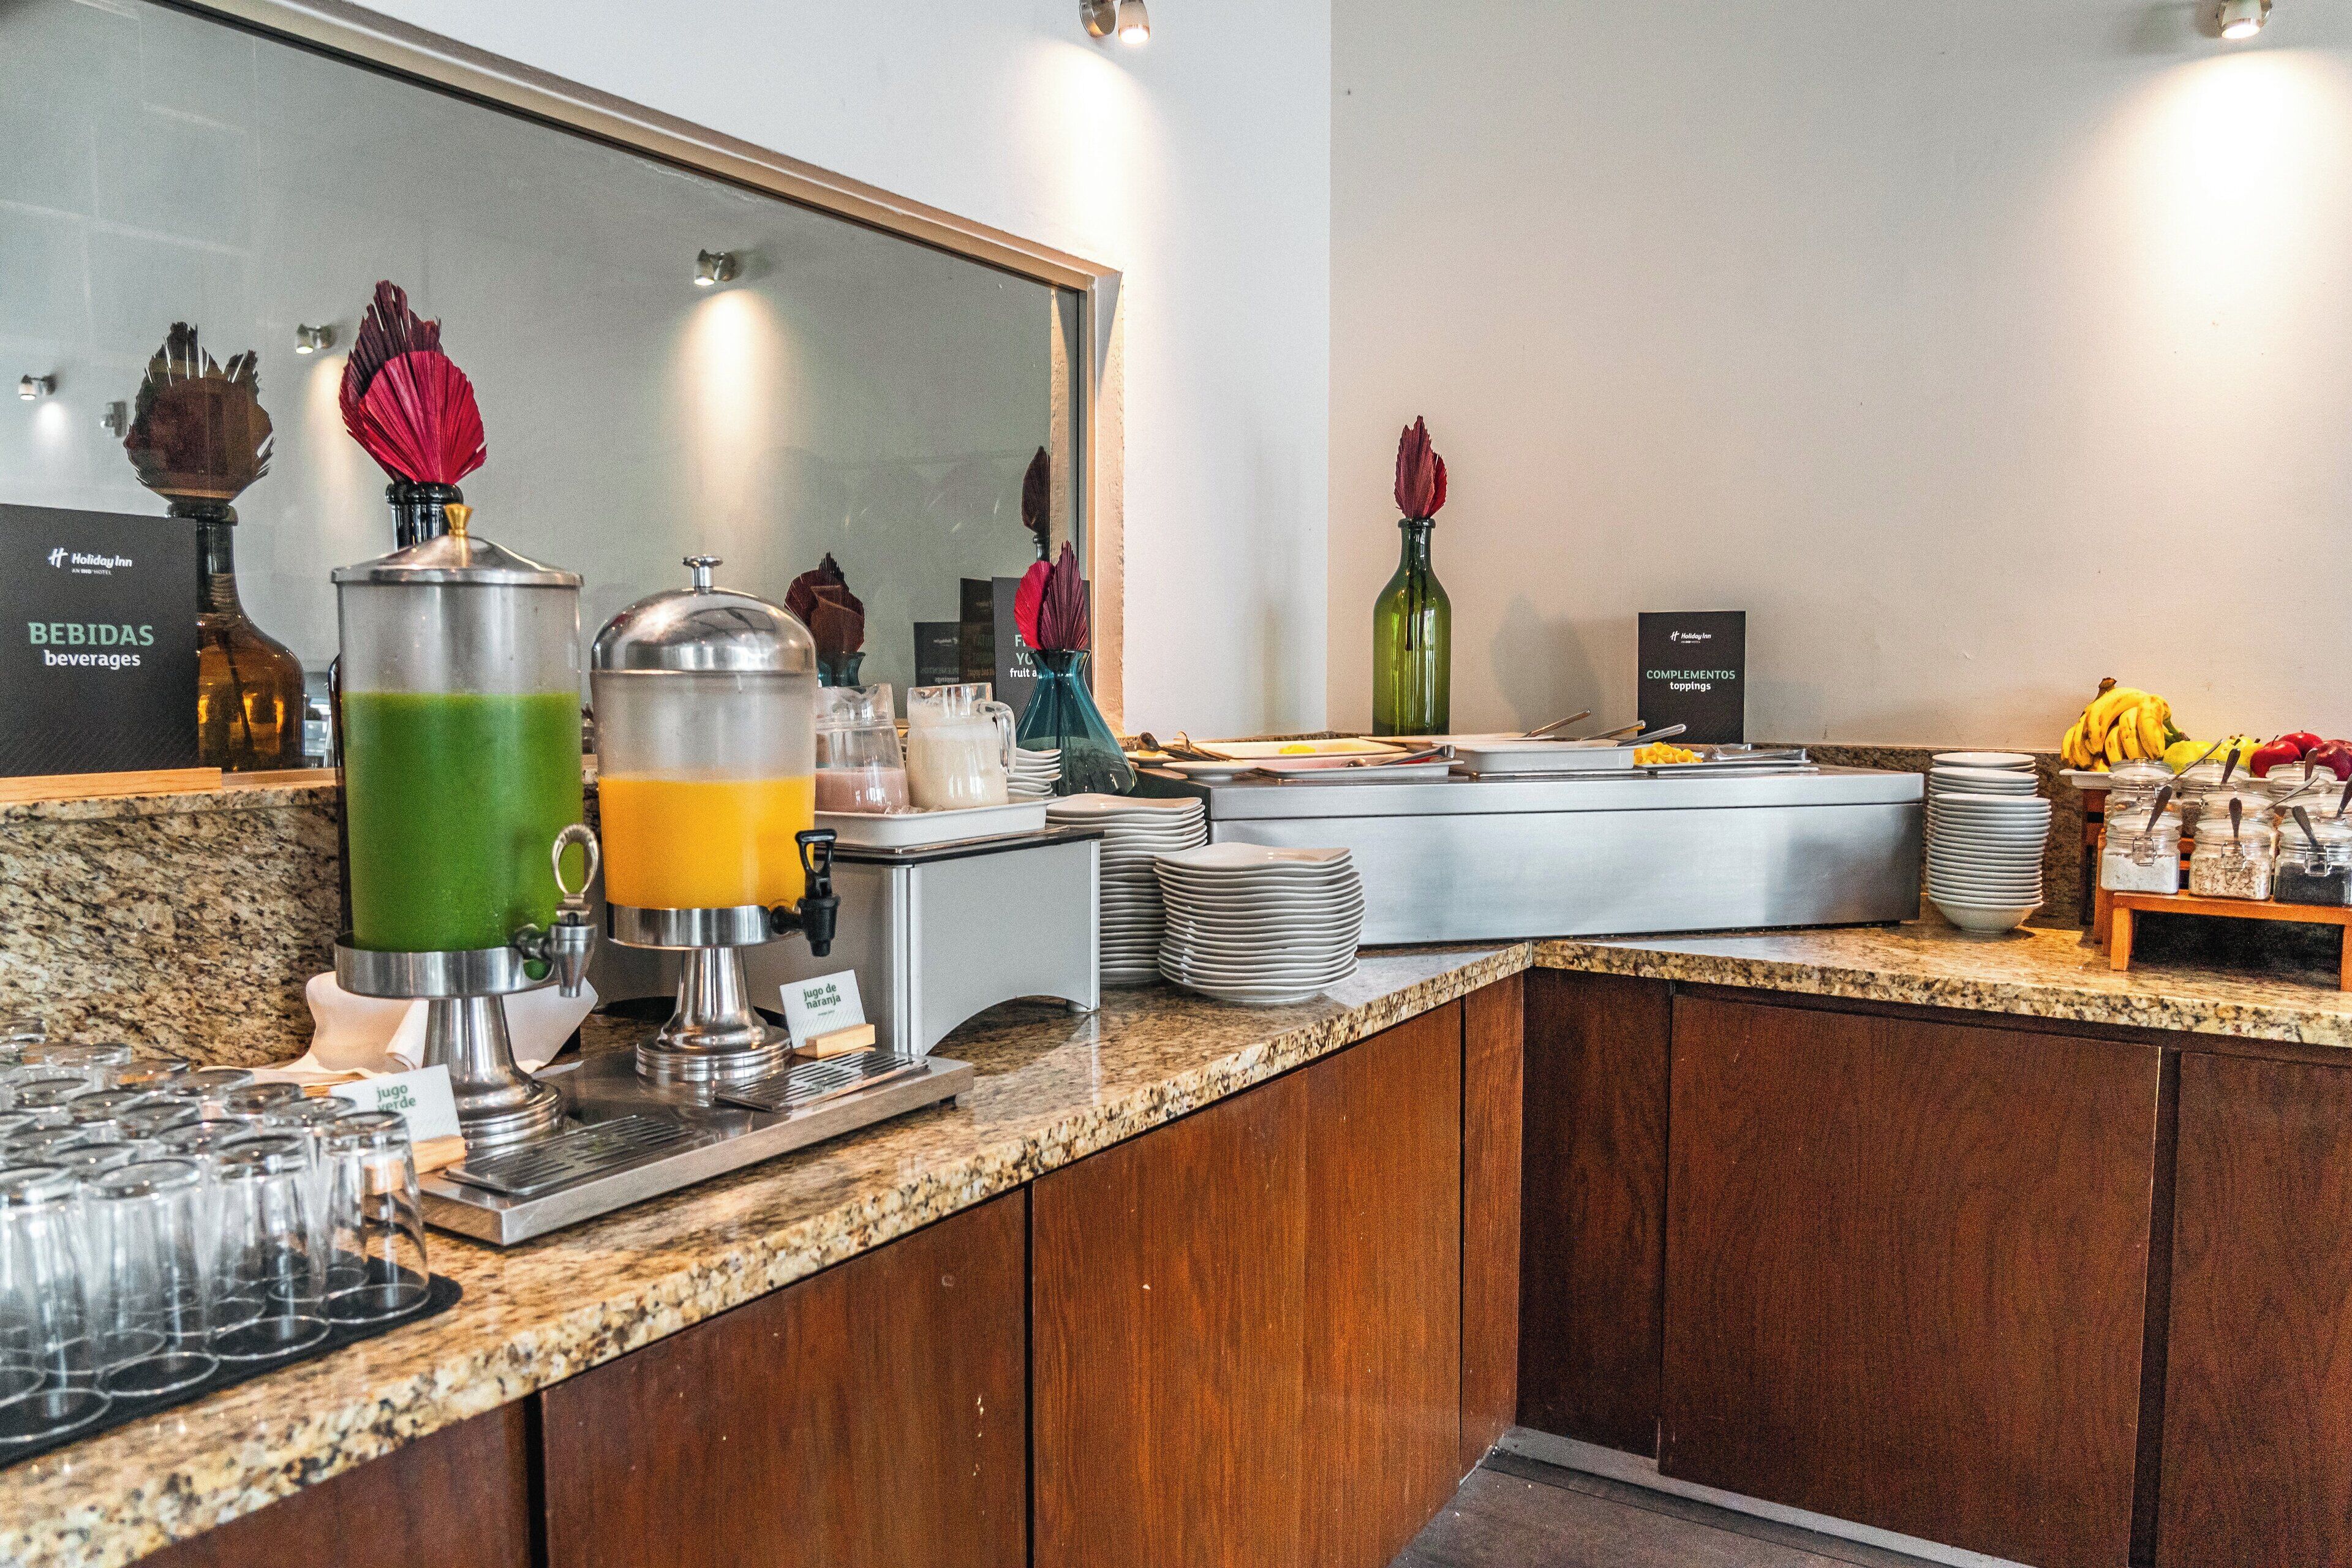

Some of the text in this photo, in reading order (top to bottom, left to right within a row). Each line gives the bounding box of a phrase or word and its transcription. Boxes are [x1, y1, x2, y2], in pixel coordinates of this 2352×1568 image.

[72, 552, 132, 568] Holiday Inn
[28, 622, 154, 646] BEBIDAS
[44, 650, 141, 670] beverages
[1009, 668, 1030, 677] fruit
[1646, 670, 1736, 680] COMPLEMENTOS
[1670, 681, 1711, 692] toppings
[804, 983, 837, 1001] jugo de
[806, 993, 841, 1009] naranja
[377, 1085, 407, 1102] jugo
[377, 1096, 415, 1111] verde
